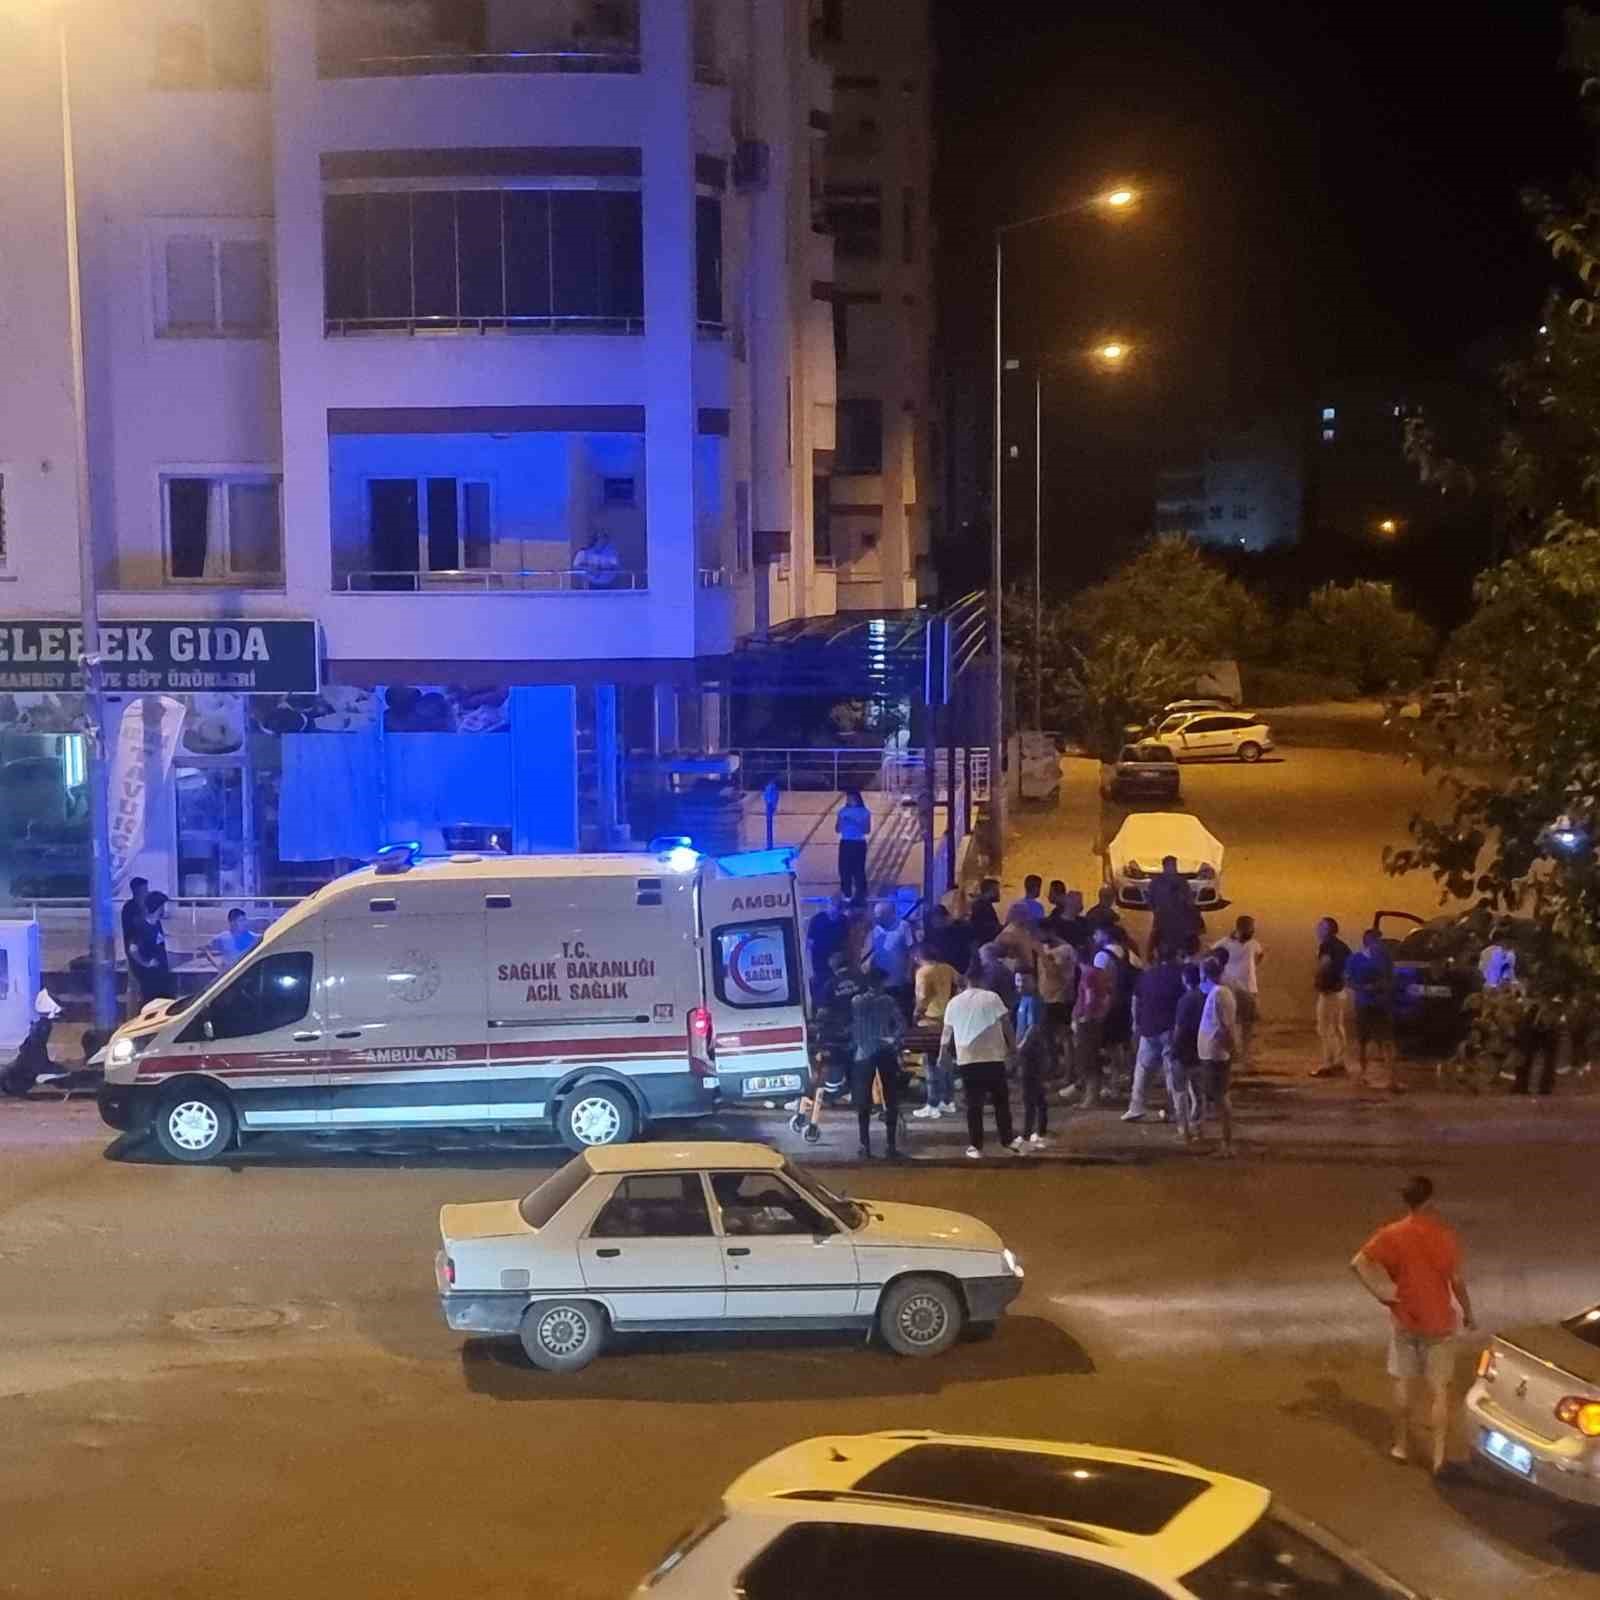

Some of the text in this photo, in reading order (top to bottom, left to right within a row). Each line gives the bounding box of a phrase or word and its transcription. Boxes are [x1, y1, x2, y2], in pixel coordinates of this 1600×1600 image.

[169, 626, 270, 662] GIDA
[127, 668, 162, 688] SÜT
[731, 893, 790, 913] AMBU
[561, 941, 591, 959] T.C.
[566, 958, 655, 979] BAKANLIĞI
[526, 980, 629, 1003] ACİL SAĞLIK
[367, 1046, 457, 1062] AMBULANS
